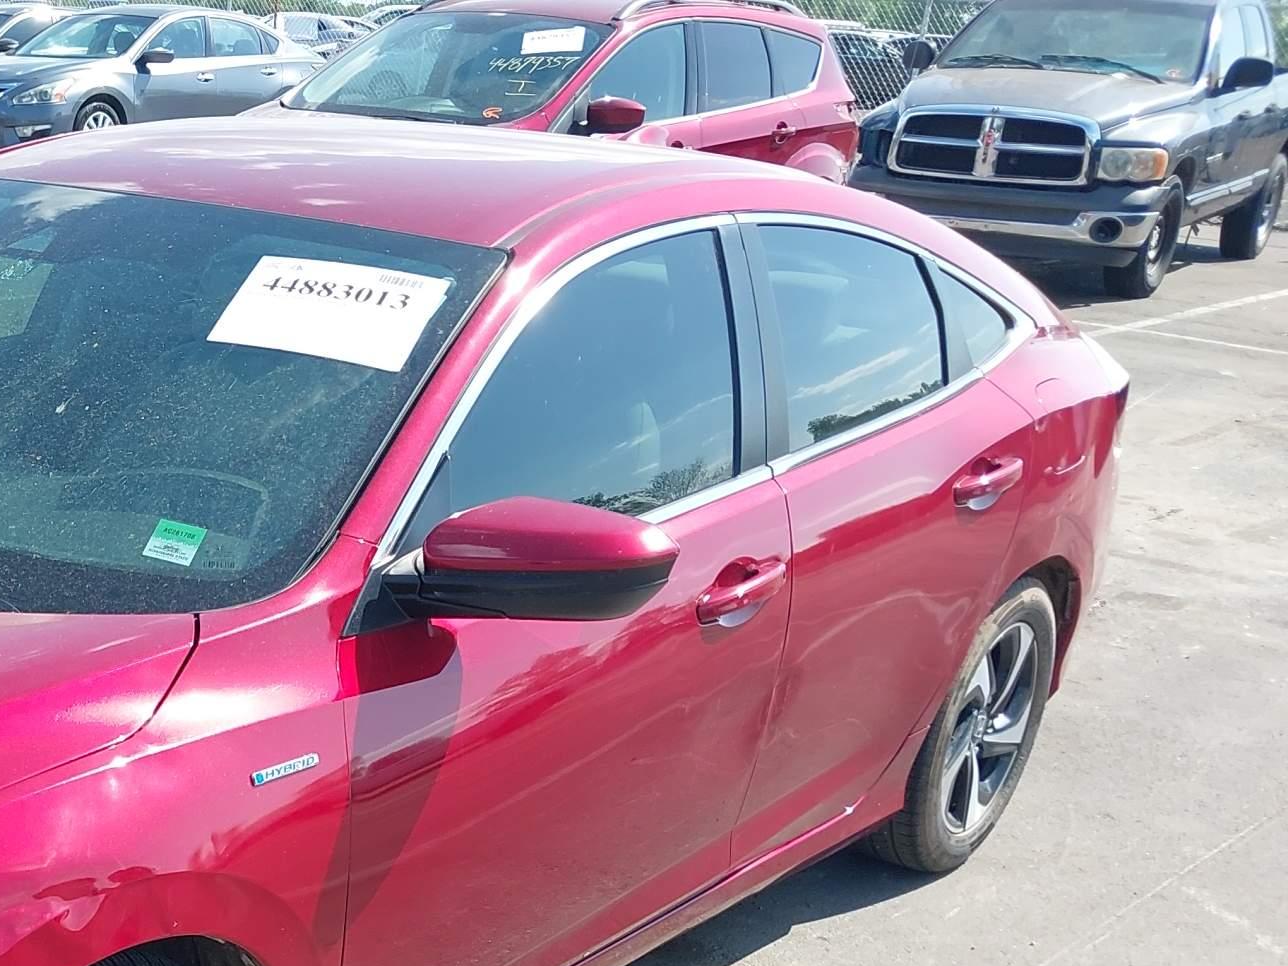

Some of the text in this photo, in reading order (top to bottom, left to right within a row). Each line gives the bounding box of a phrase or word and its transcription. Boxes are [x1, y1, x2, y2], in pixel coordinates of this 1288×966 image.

[487, 56, 581, 75] 44879357
[263, 276, 411, 310] 44883013
[265, 755, 316, 779] HYBRID
